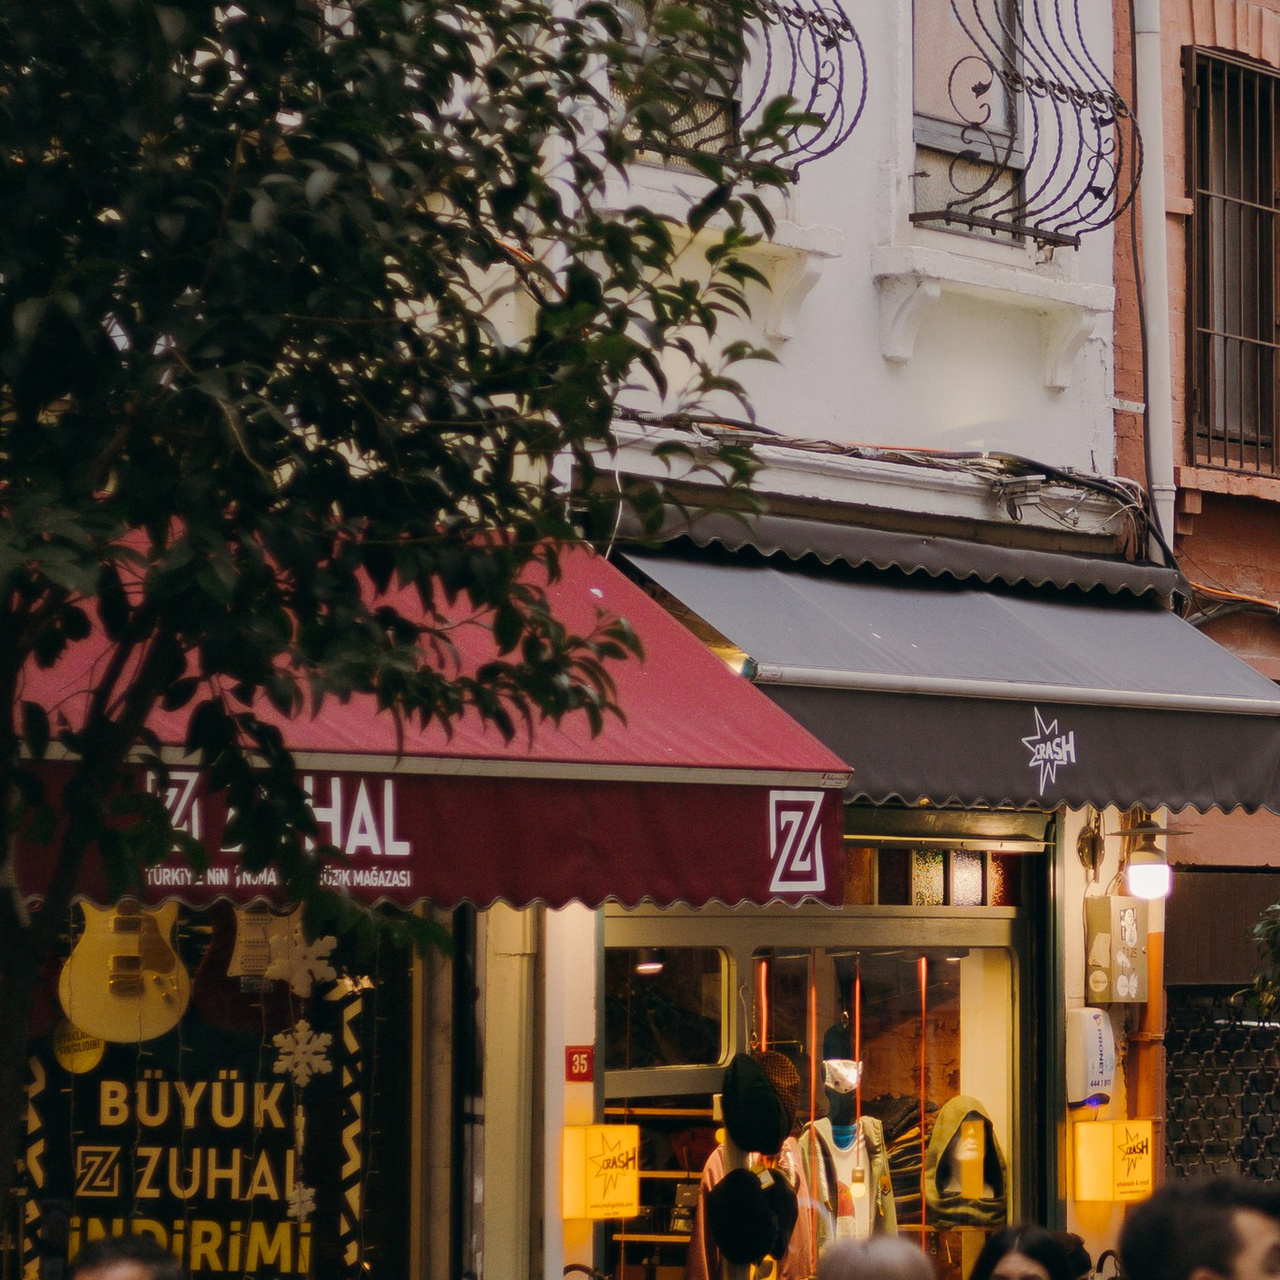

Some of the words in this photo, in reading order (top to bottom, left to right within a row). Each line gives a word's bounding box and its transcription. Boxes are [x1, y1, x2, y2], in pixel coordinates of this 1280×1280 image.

[1035, 731, 1076, 763] CRASH
[571, 1053, 588, 1074] 35
[1090, 1079, 1100, 1087] 444
[99, 1069, 286, 1129] BÜYÜK
[602, 1146, 637, 1171] CRASH
[1127, 1137, 1149, 1157] CRASH
